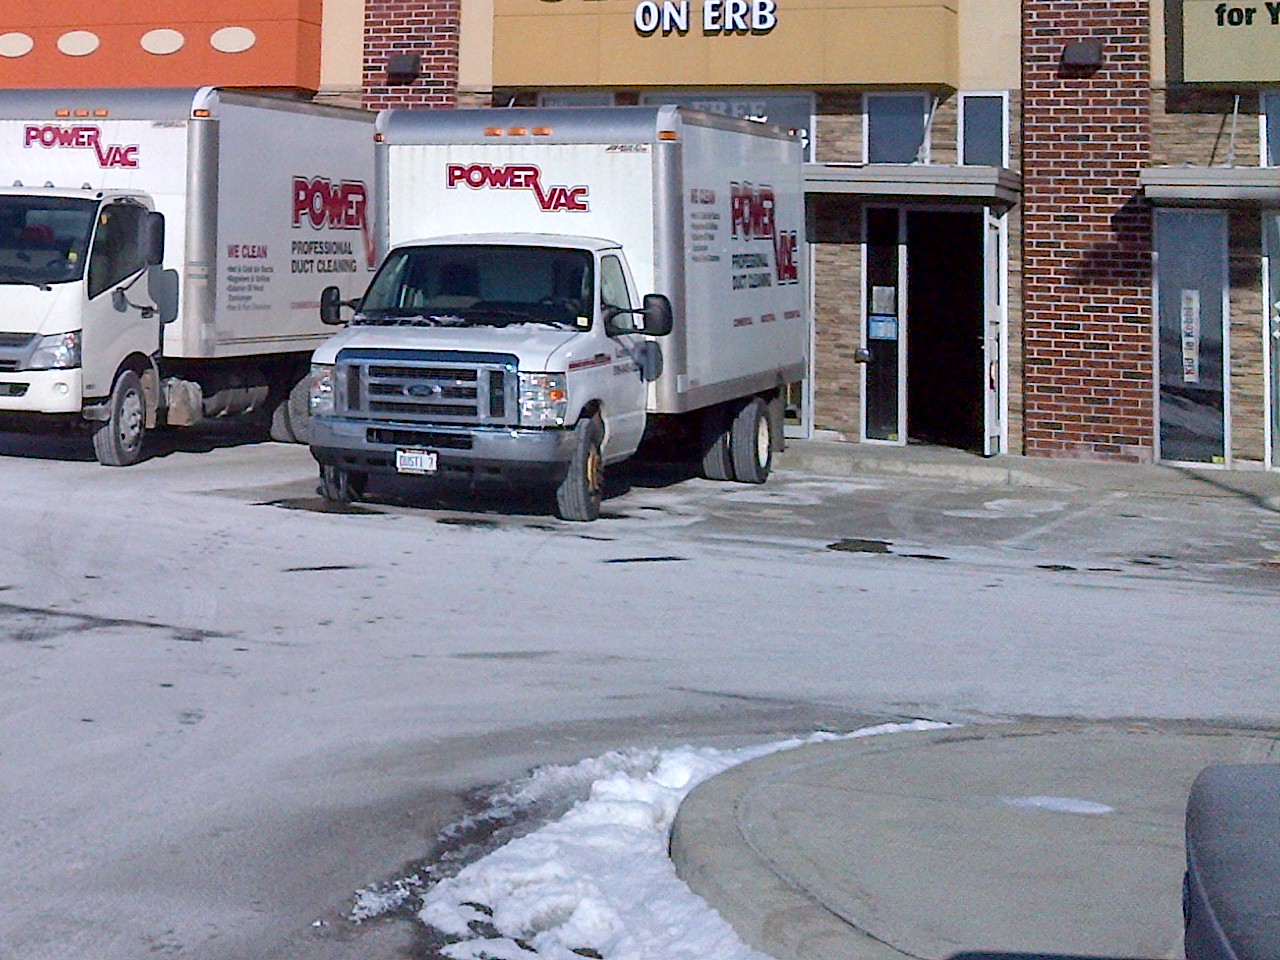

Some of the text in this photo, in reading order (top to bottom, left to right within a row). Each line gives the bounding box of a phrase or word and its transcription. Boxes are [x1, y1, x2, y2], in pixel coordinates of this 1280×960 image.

[634, 0, 689, 36] ON
[1215, 3, 1256, 26] for
[24, 124, 139, 168] POWER VAC
[292, 176, 366, 230] POWER
[446, 163, 590, 212] POWER VAC
[291, 241, 352, 254] PROFESSIONAL
[731, 181, 776, 241] POWER
[773, 230, 798, 285] VAC
[242, 245, 267, 258] CLEAN
[291, 259, 357, 273] DUCT CLEANING
